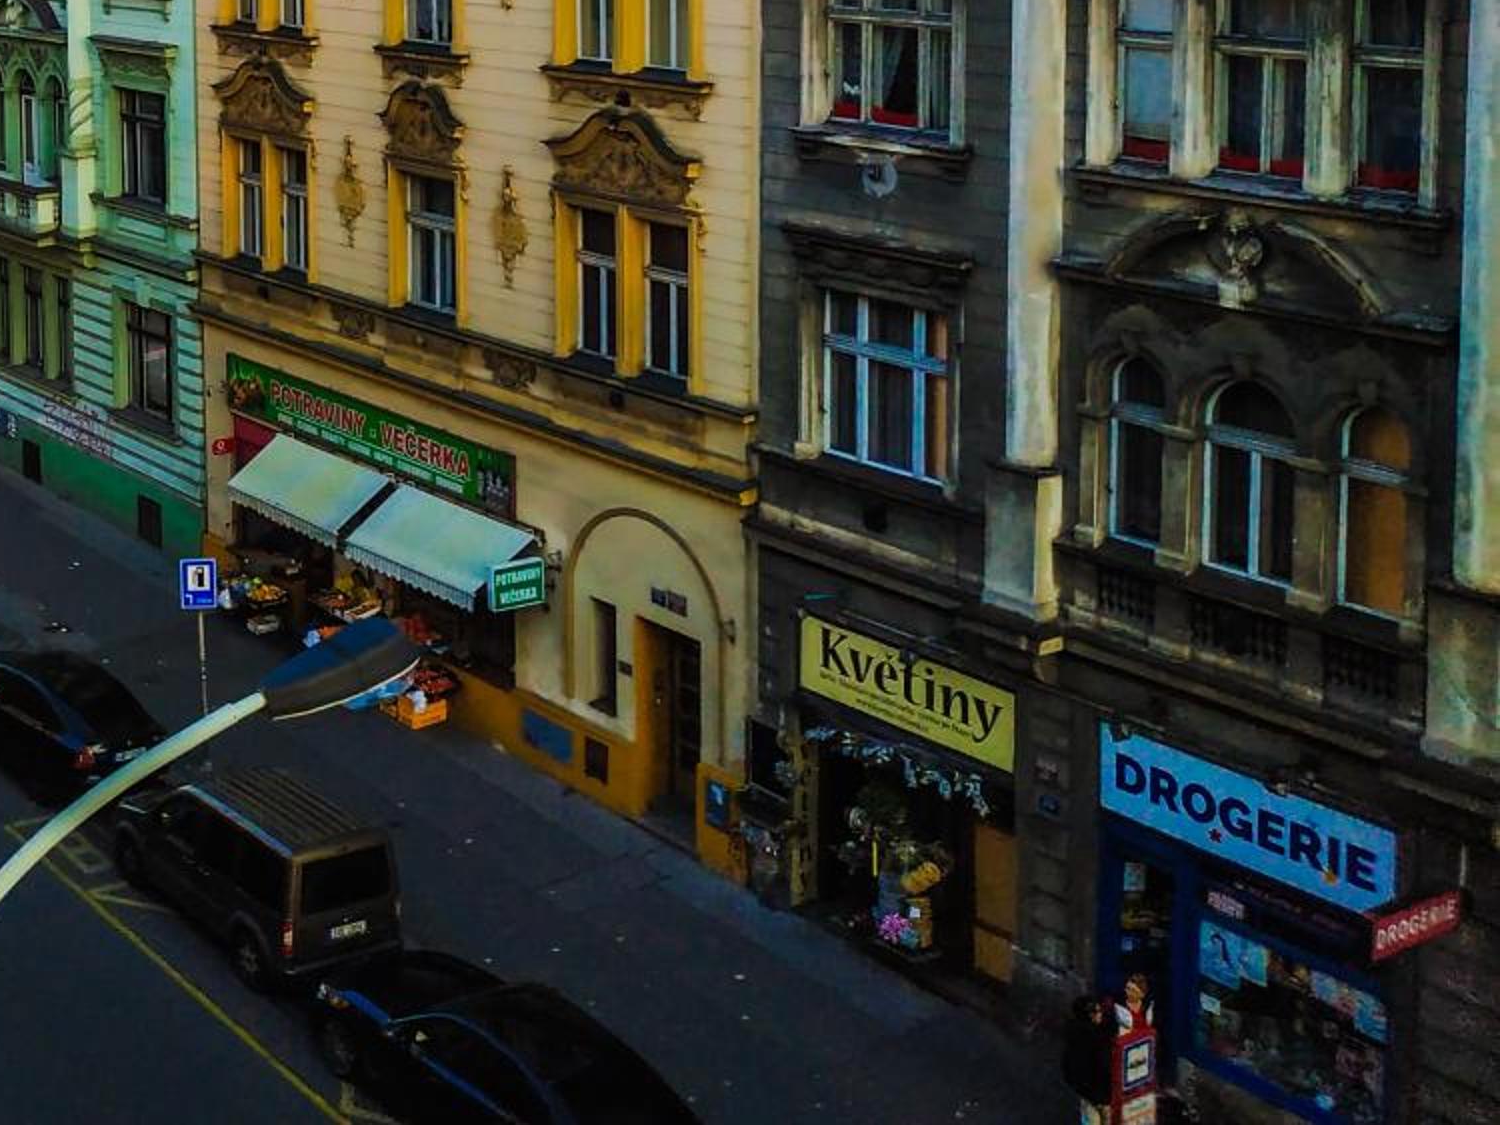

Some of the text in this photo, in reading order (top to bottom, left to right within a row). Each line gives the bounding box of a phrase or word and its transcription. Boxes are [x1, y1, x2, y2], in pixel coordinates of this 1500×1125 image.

[270, 379, 367, 437] POTRAVINY
[380, 421, 471, 479] VEČERKA
[819, 626, 1004, 744] Květiny
[1115, 752, 1378, 893] DROGERIE
[1375, 898, 1457, 951] DROGERIE
